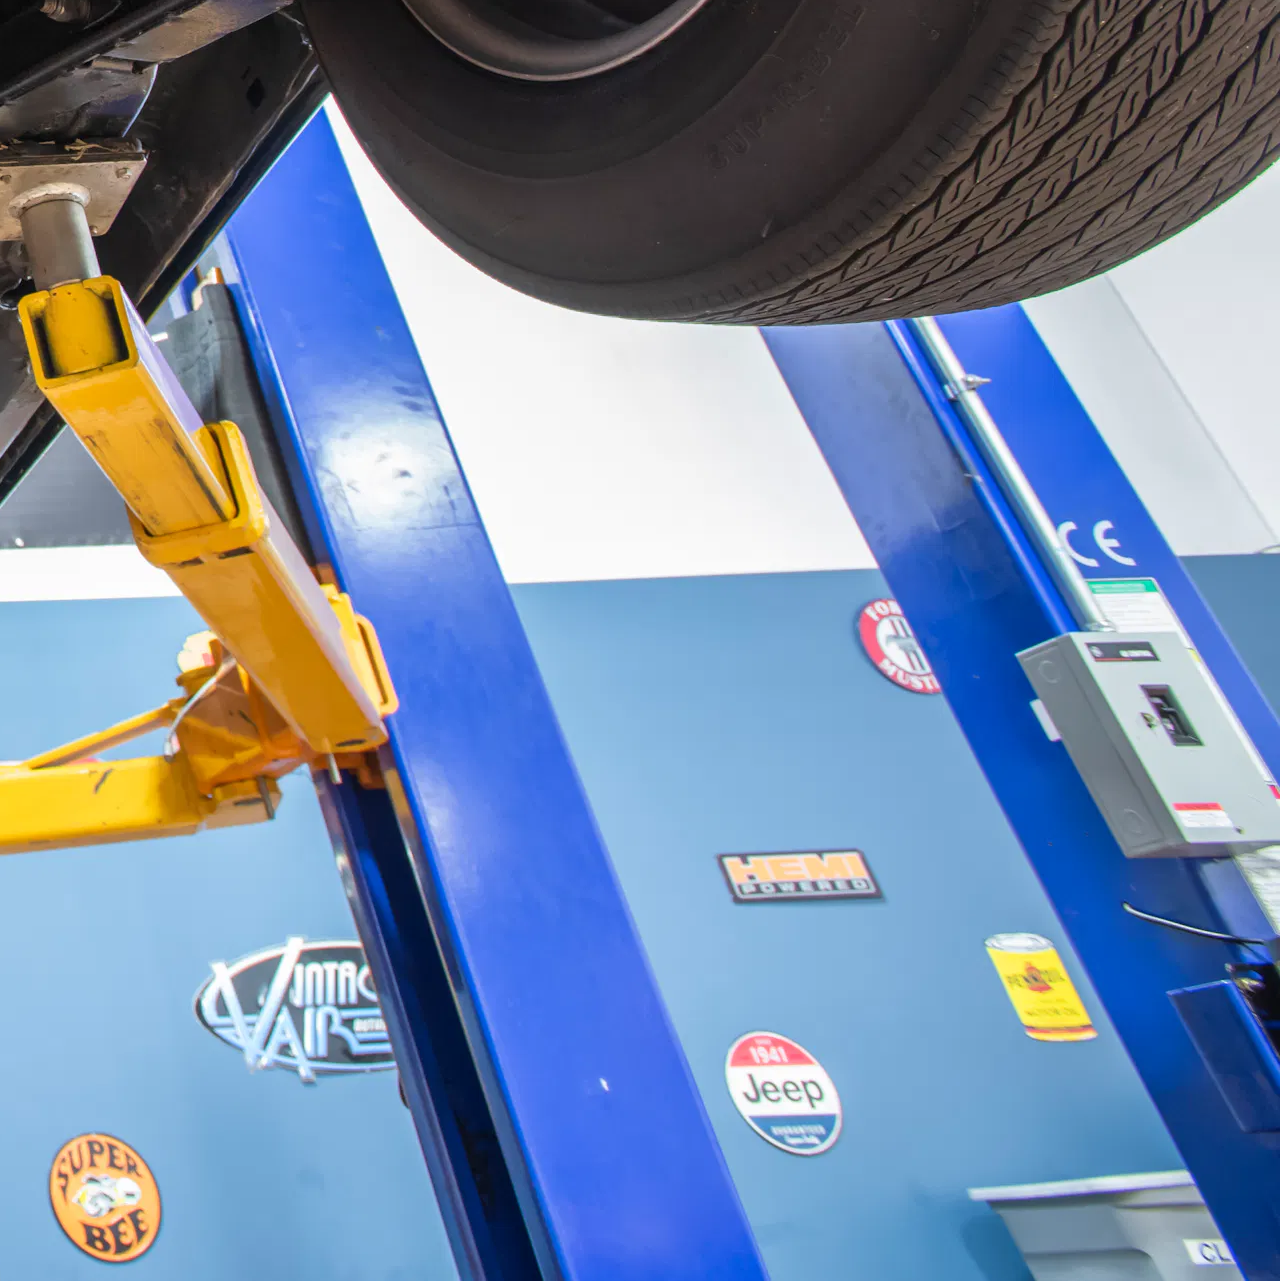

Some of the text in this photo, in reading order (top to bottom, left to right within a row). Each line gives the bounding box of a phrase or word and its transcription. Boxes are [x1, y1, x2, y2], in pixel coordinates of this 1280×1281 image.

[1057, 520, 1137, 567] CE
[725, 854, 868, 884] HEMI
[741, 879, 869, 894] POWERED
[748, 1046, 789, 1064] 1941
[742, 1073, 824, 1109] Jeep
[57, 1139, 143, 1205] SUPER
[78, 1207, 148, 1255] BEE
[1200, 1242, 1233, 1264] CL
